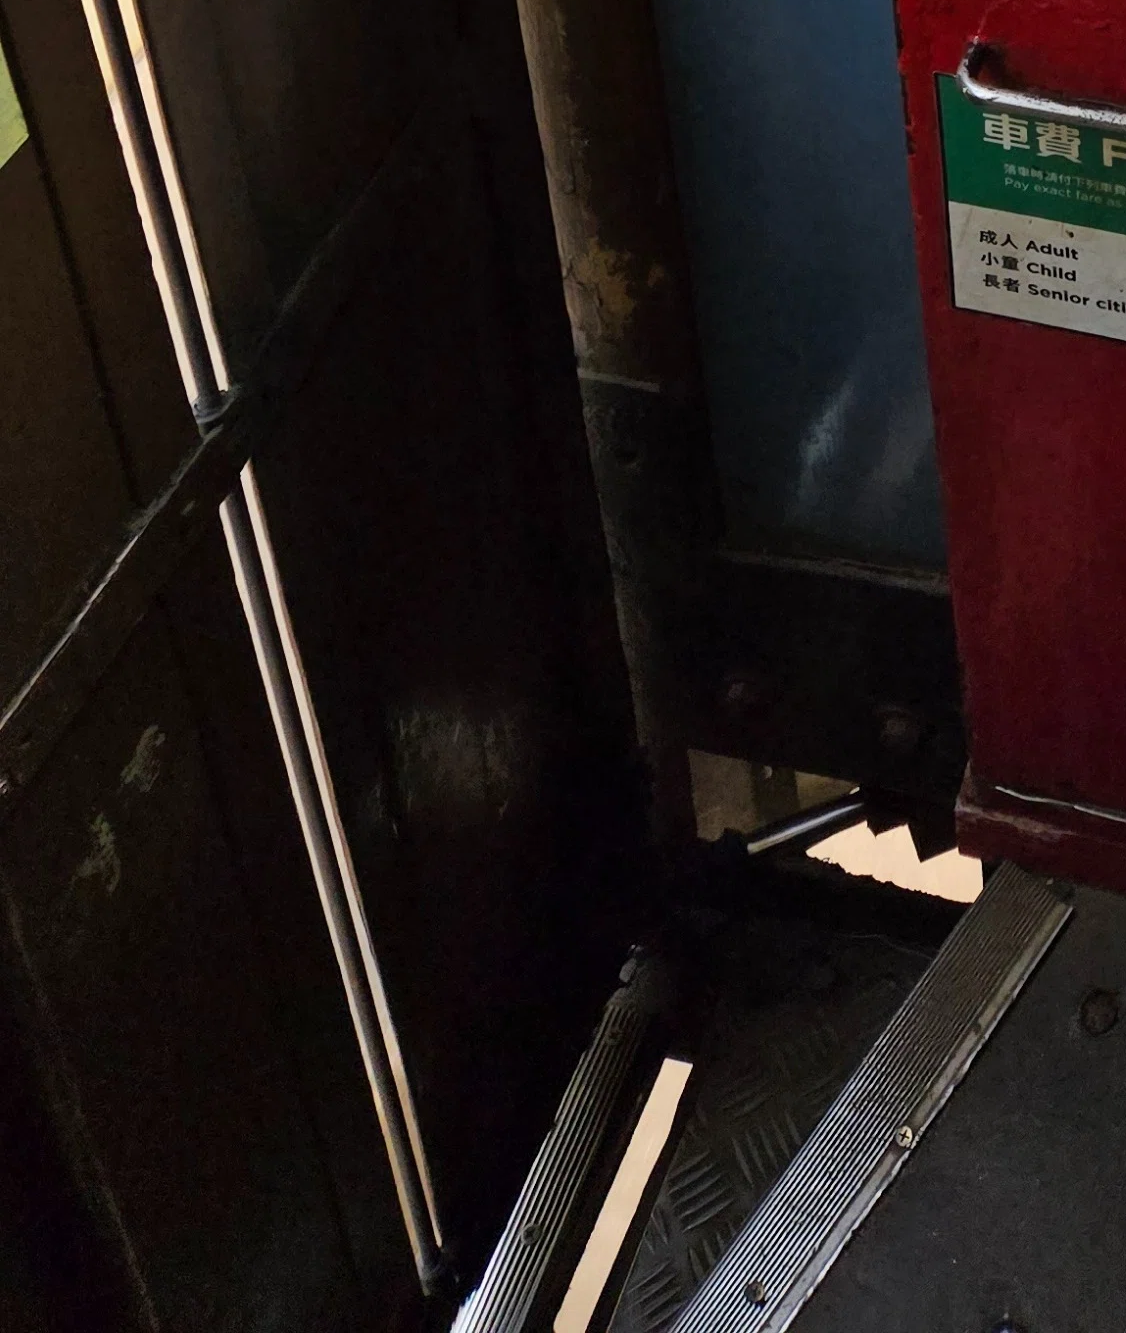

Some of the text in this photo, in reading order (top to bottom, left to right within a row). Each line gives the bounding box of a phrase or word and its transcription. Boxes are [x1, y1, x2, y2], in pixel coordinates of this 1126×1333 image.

[982, 112, 1082, 164] 車費
[1004, 177, 1029, 192] Pay
[1033, 184, 1073, 199] exact
[1076, 189, 1103, 205] fare
[1106, 198, 1122, 209] as
[979, 229, 1079, 261] 成人 Adult
[980, 251, 1077, 282] 小童 Child
[982, 274, 1020, 294] 長者
[1027, 283, 1090, 306] Senior
